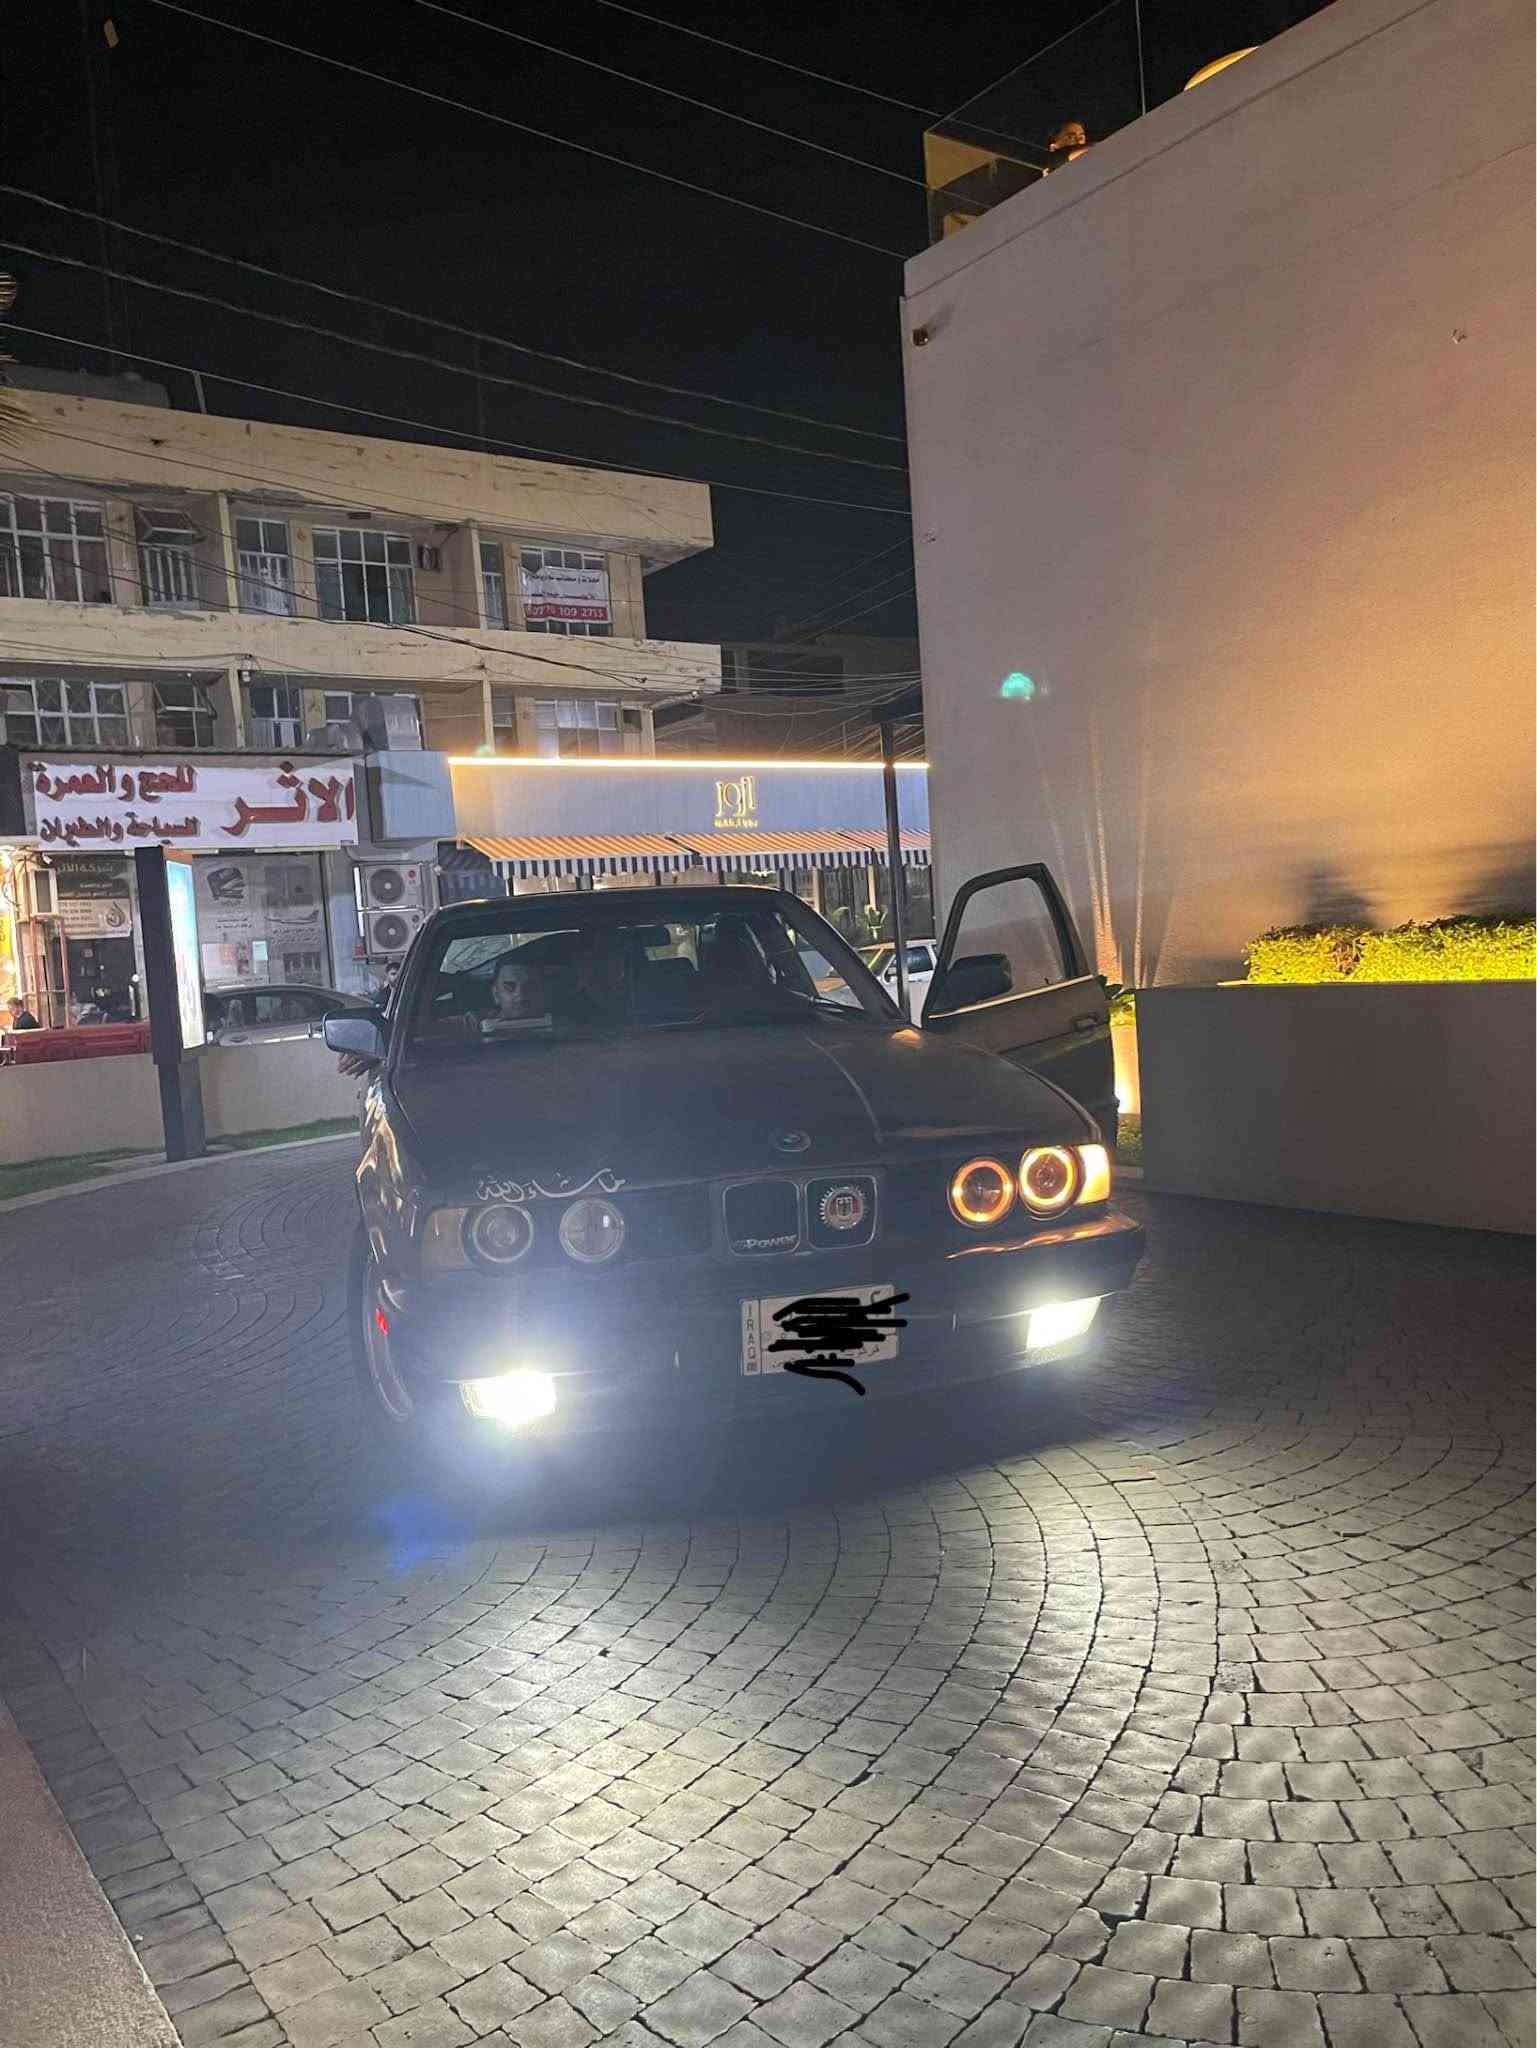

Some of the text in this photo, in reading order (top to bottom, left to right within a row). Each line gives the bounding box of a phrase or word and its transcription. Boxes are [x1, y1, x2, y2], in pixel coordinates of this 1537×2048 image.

[27, 761, 116, 802] العمرة
[138, 763, 197, 802] للحج
[746, 1303, 757, 1359] IRAQ
